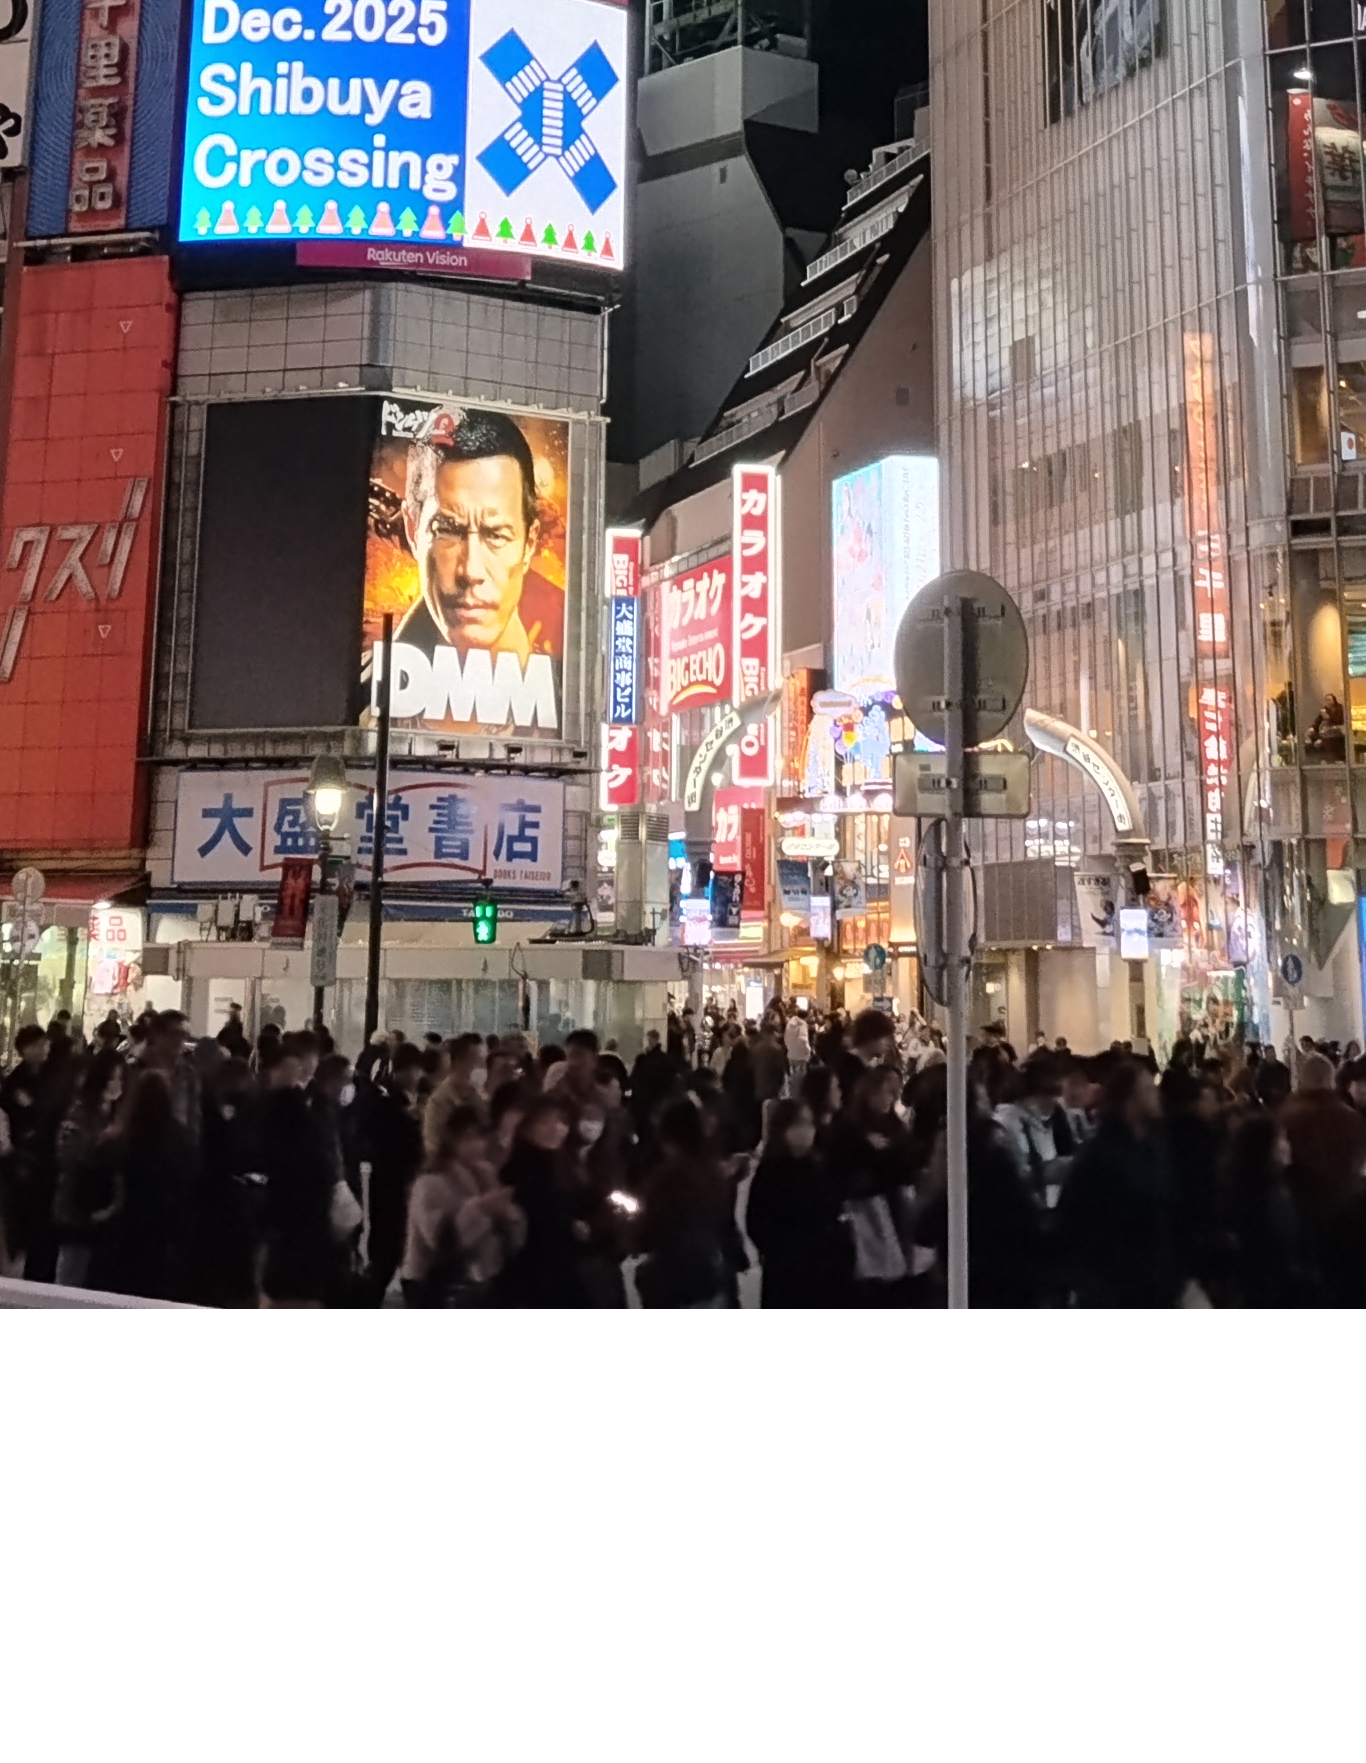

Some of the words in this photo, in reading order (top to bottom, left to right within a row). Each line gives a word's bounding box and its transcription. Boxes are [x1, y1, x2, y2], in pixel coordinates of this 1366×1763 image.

[196, 62, 432, 125] Shibuya
[193, 134, 459, 201] Crossing
[367, 246, 423, 265] Rakuten
[426, 251, 468, 267] Vision
[613, 553, 630, 588] BIG
[739, 487, 770, 640] カラオケ
[668, 569, 726, 630] カラオケ
[371, 641, 559, 728] DMM
[614, 603, 634, 718] 大盛堂商事ビル
[669, 656, 690, 700] BIG
[690, 643, 725, 687] ECHO
[197, 792, 543, 863] 大盛堂書店
[493, 868, 518, 880] BOOKS
